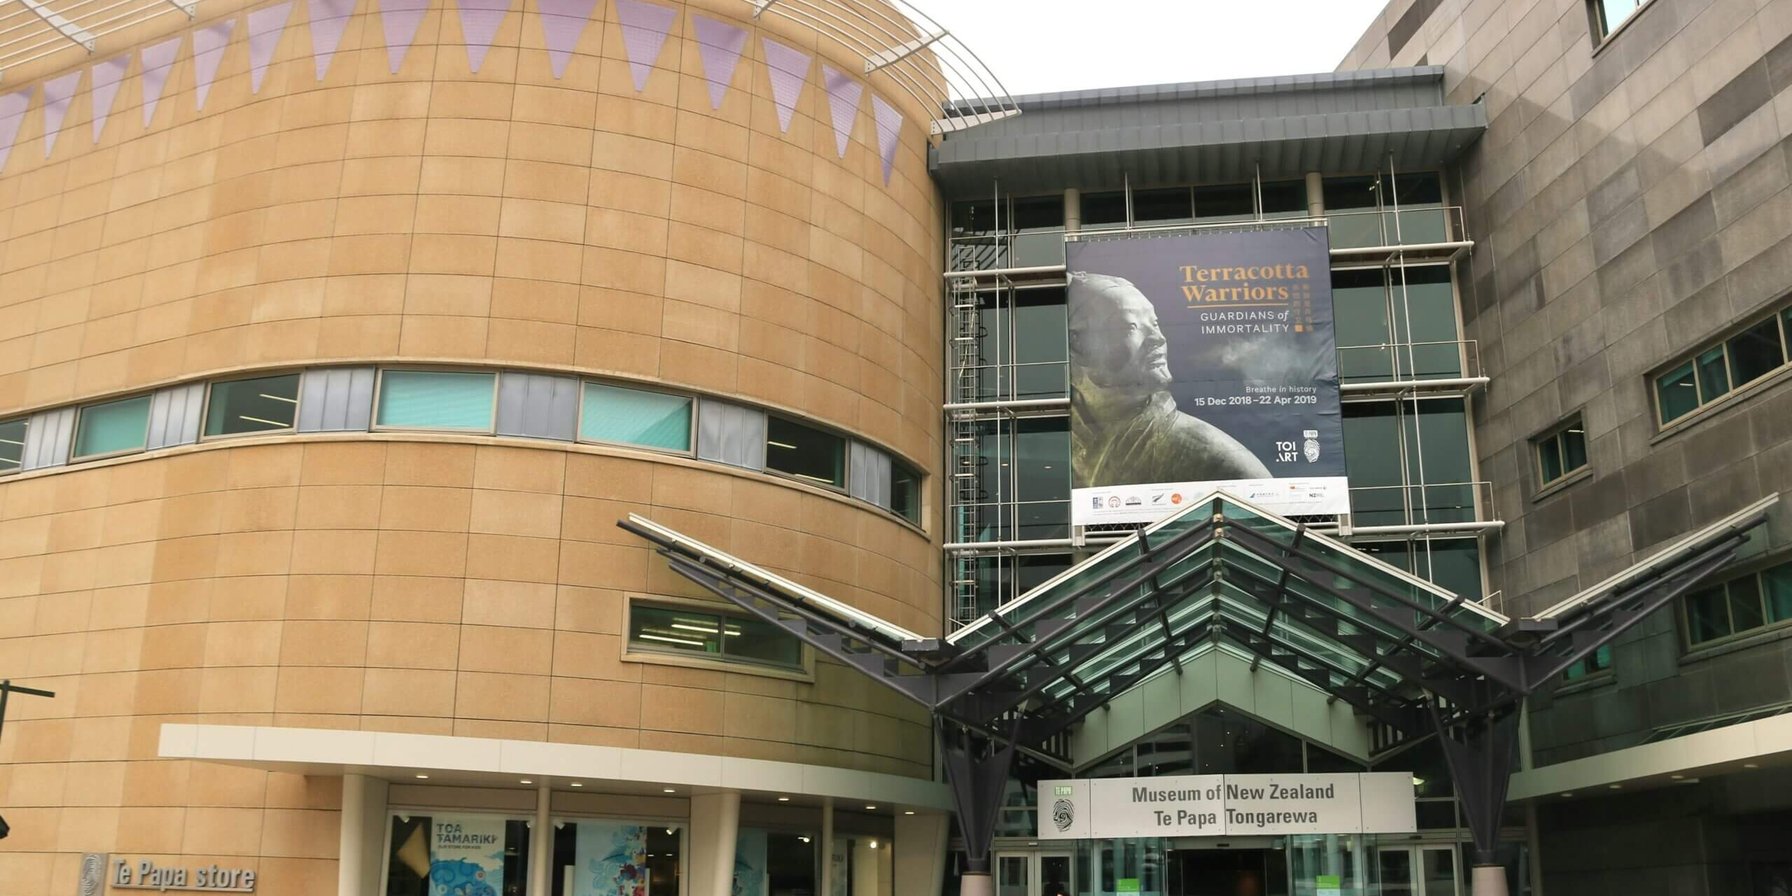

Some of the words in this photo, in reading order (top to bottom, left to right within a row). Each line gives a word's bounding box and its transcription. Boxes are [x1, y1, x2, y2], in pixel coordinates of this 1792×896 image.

[1179, 263, 1310, 283] Terracotta
[1181, 282, 1289, 303] Warriors
[1200, 310, 1275, 322] GUARDIANS
[1277, 310, 1290, 322] of
[1201, 323, 1290, 335] IMMORTALITY
[1245, 385, 1277, 394] Breathe
[1279, 385, 1287, 393] in
[1289, 385, 1317, 395] history
[1194, 397, 1206, 407] 15
[1207, 397, 1228, 406] Dec
[1273, 395, 1292, 406] Apr
[1294, 395, 1317, 405] 2019
[1275, 441, 1296, 452] TOI
[1132, 785, 1201, 803] Museum
[1206, 784, 1222, 801] of
[1226, 783, 1265, 800] New
[1269, 783, 1336, 800] Zealand
[1153, 810, 1172, 827] Te
[1177, 809, 1217, 830] Papa
[1226, 808, 1318, 828] Tongarewa
[436, 823, 462, 834] TOA
[112, 858, 132, 886] Te
[137, 859, 188, 892] Papa
[195, 864, 257, 889] store
